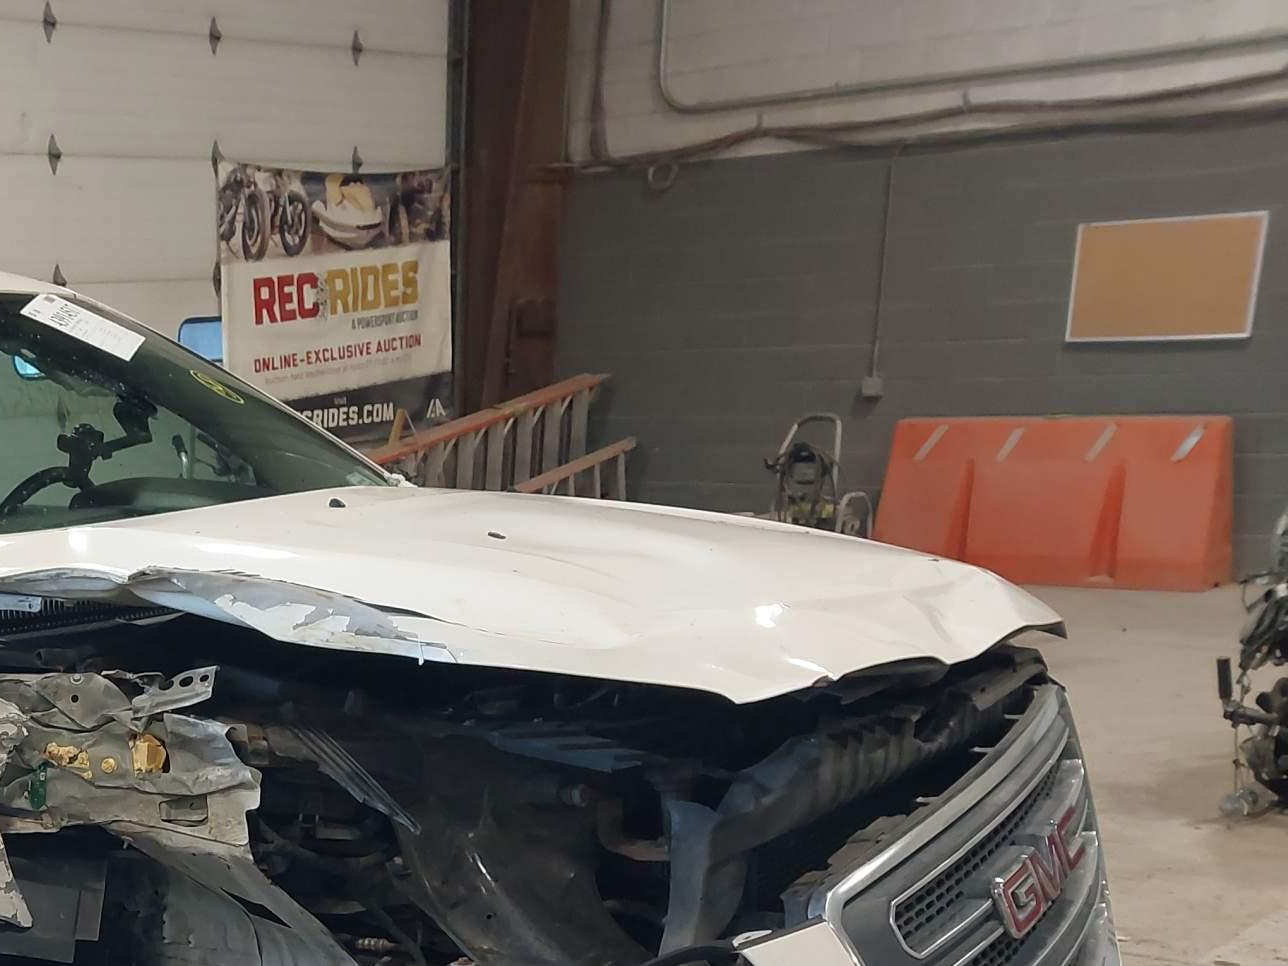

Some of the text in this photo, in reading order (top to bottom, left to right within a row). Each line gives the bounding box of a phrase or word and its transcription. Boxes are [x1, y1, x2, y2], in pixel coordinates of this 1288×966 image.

[253, 261, 419, 325] REC RIDES
[254, 343, 371, 373] ONLINE-EXCLUSIVE
[376, 334, 421, 354] AUCTION
[1000, 804, 1087, 936] GMC
